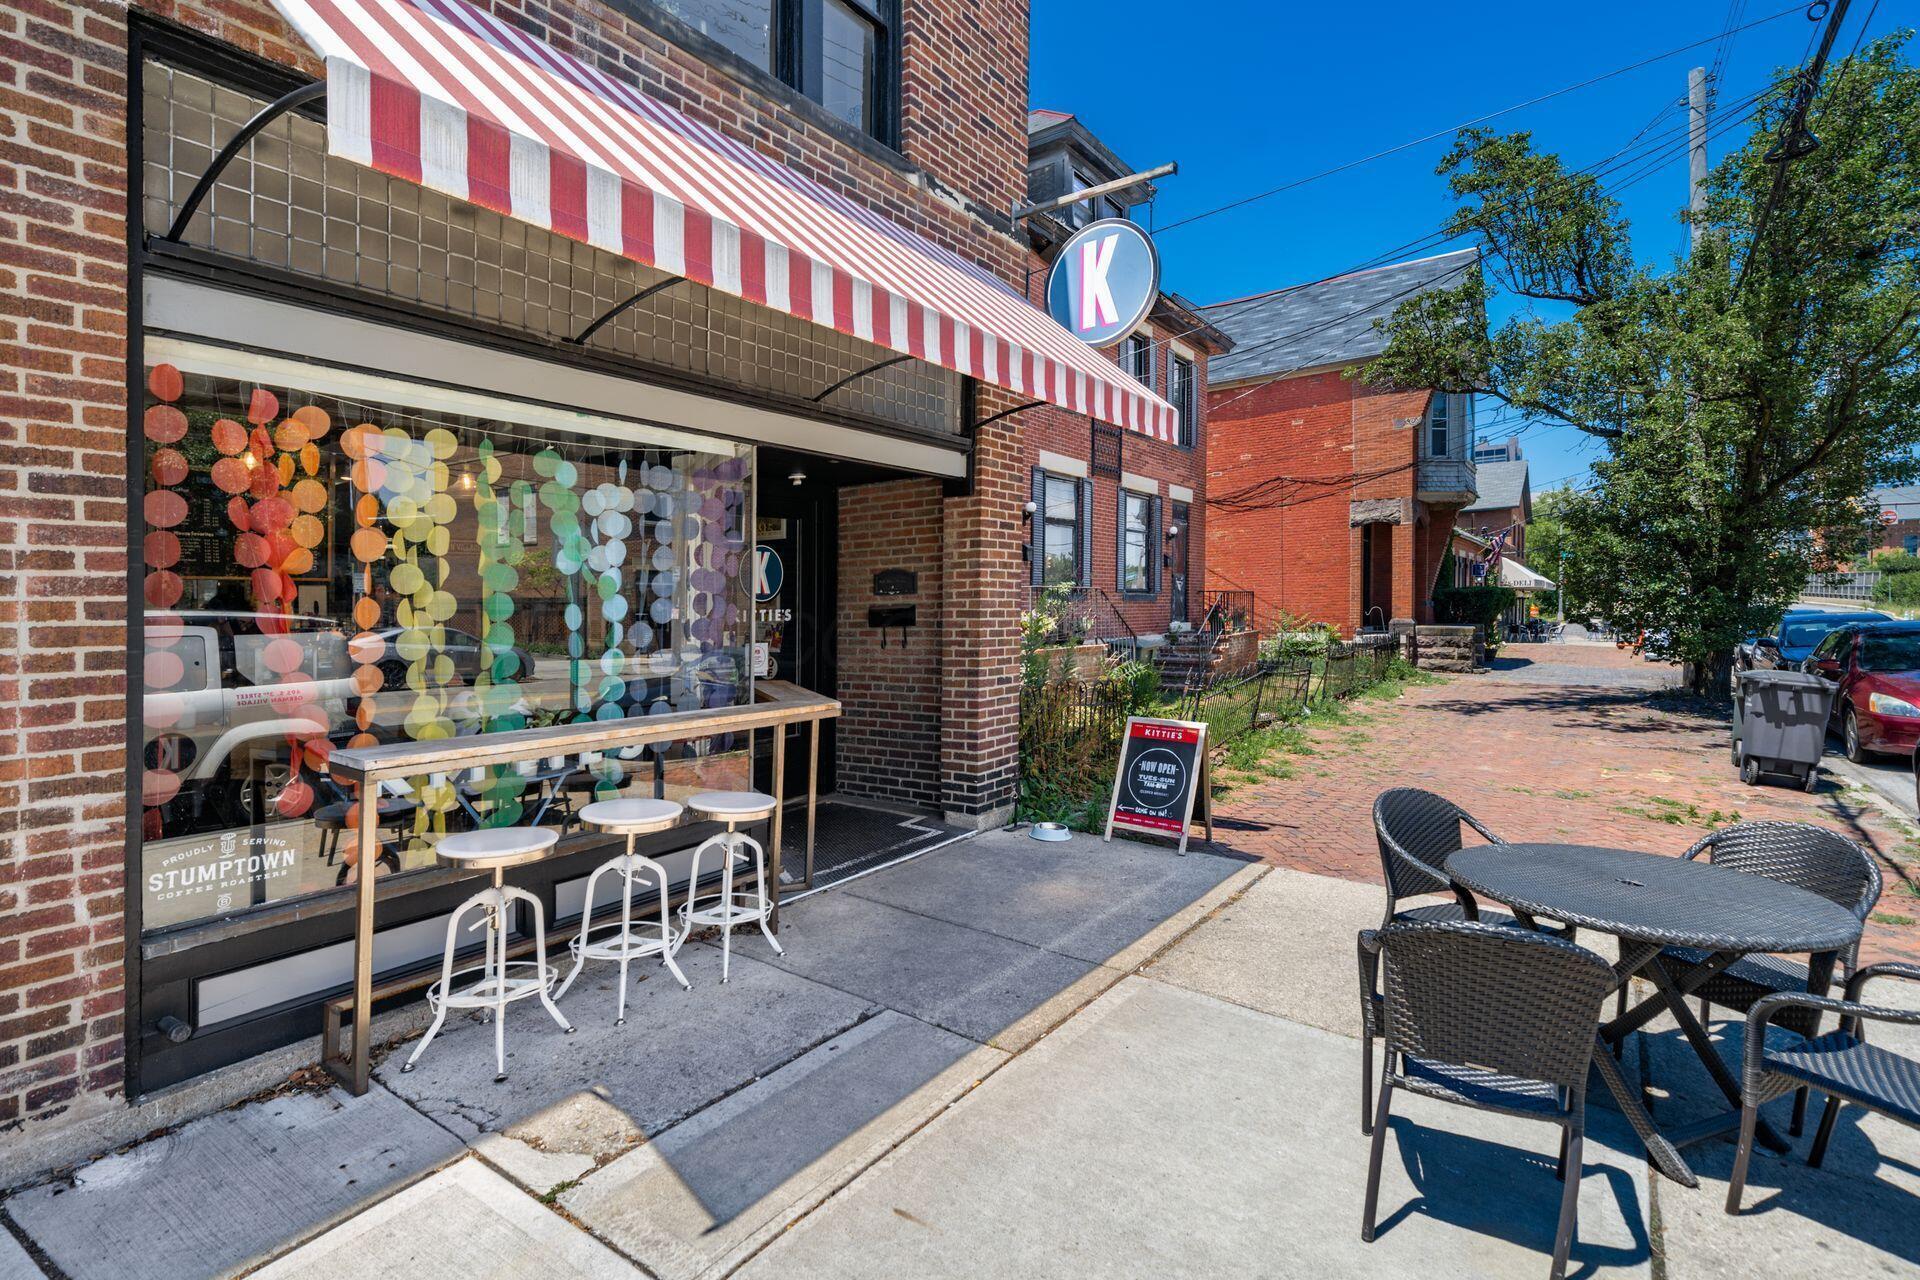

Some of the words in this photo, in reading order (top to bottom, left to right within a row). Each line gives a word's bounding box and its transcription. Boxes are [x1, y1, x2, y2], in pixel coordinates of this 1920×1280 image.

[1079, 234, 1120, 331] K
[754, 551, 771, 594] K
[735, 608, 792, 623] KITIE'S
[1145, 728, 1183, 740] KITTIE'S
[162, 844, 214, 867] PROUDLY
[242, 837, 287, 847] SERVING
[148, 848, 296, 893] STUMPTOWN
[157, 884, 214, 901] COFFEE
[220, 869, 288, 889] ROASTERS
